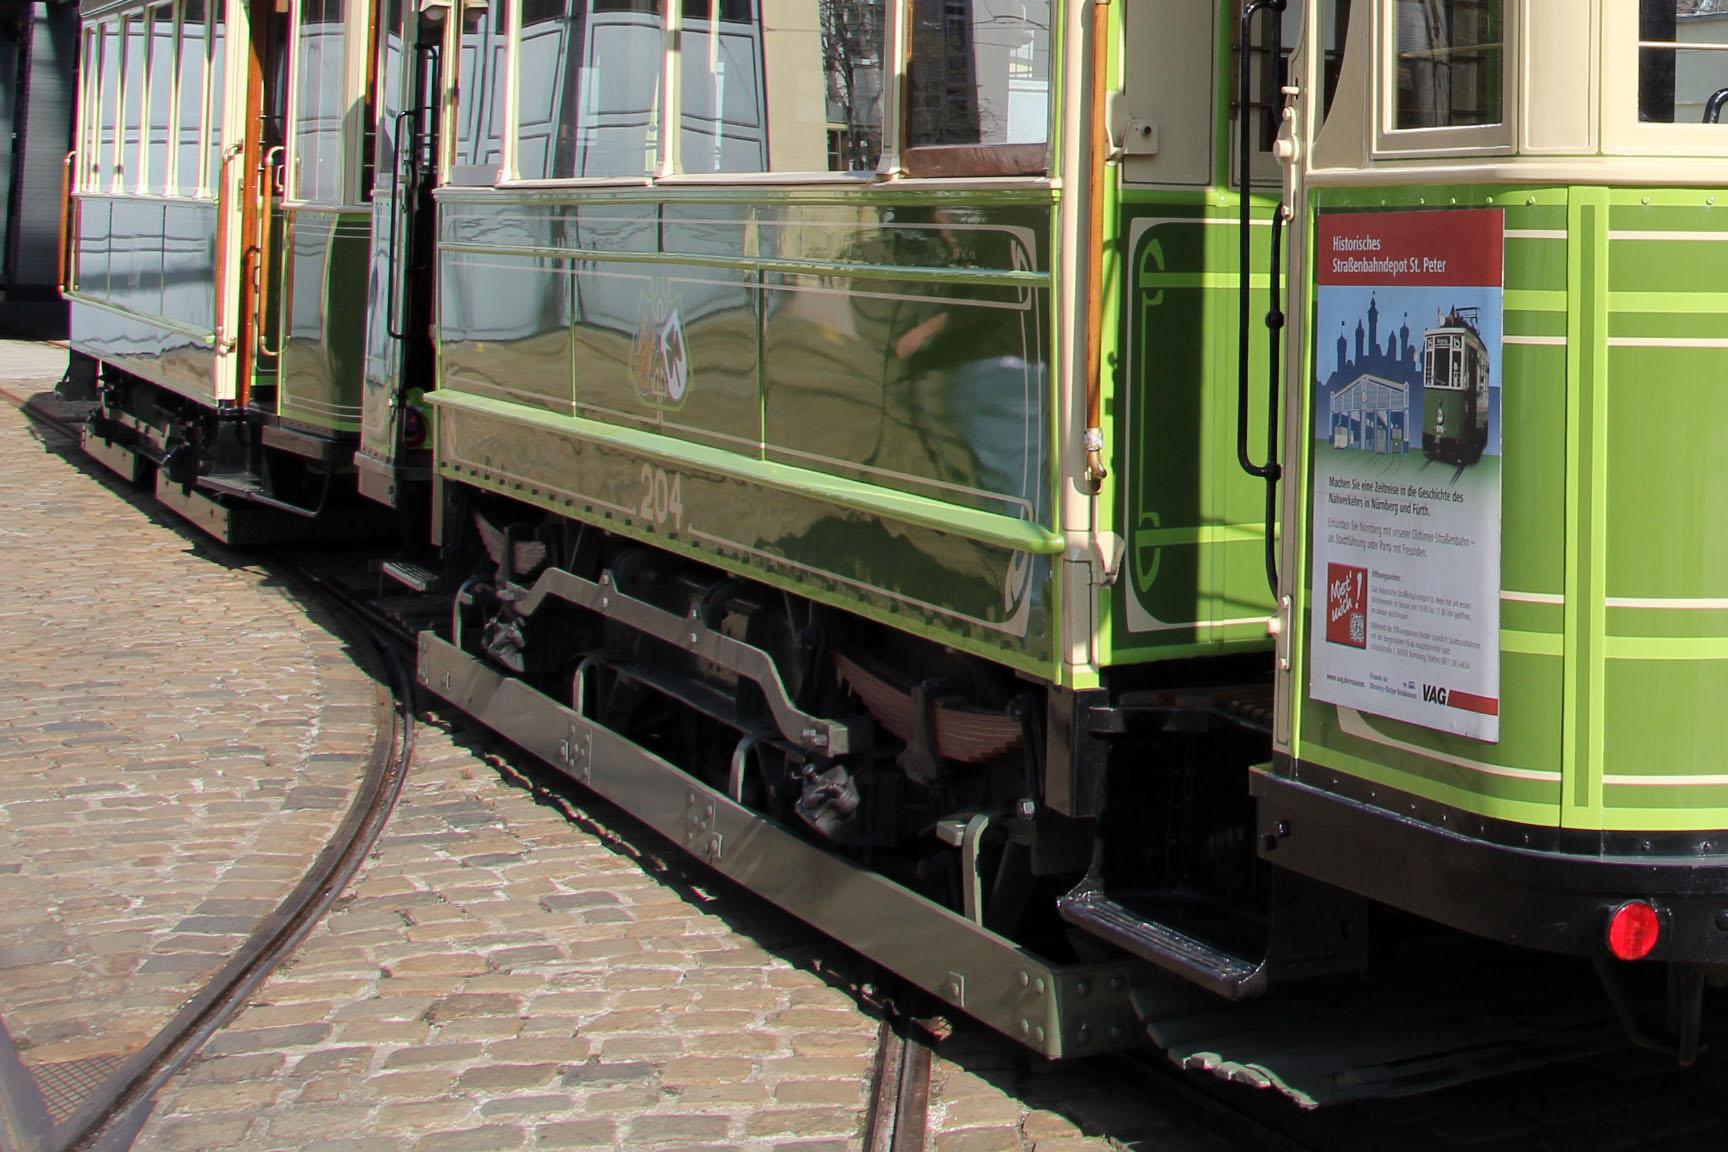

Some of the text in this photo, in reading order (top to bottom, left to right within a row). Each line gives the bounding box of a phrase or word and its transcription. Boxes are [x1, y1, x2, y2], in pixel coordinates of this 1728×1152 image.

[1333, 235, 1381, 252] Historisches
[1332, 256, 1447, 277] Straßenbahndepot St. Peter
[640, 463, 683, 531] 204
[1328, 476, 1464, 504] Machen Sie eine Zeitreise in die Geschichte des
[1328, 492, 1431, 516] Nahverkehrs in Nürnberg und Fürth.
[1422, 683, 1447, 706] VAG
